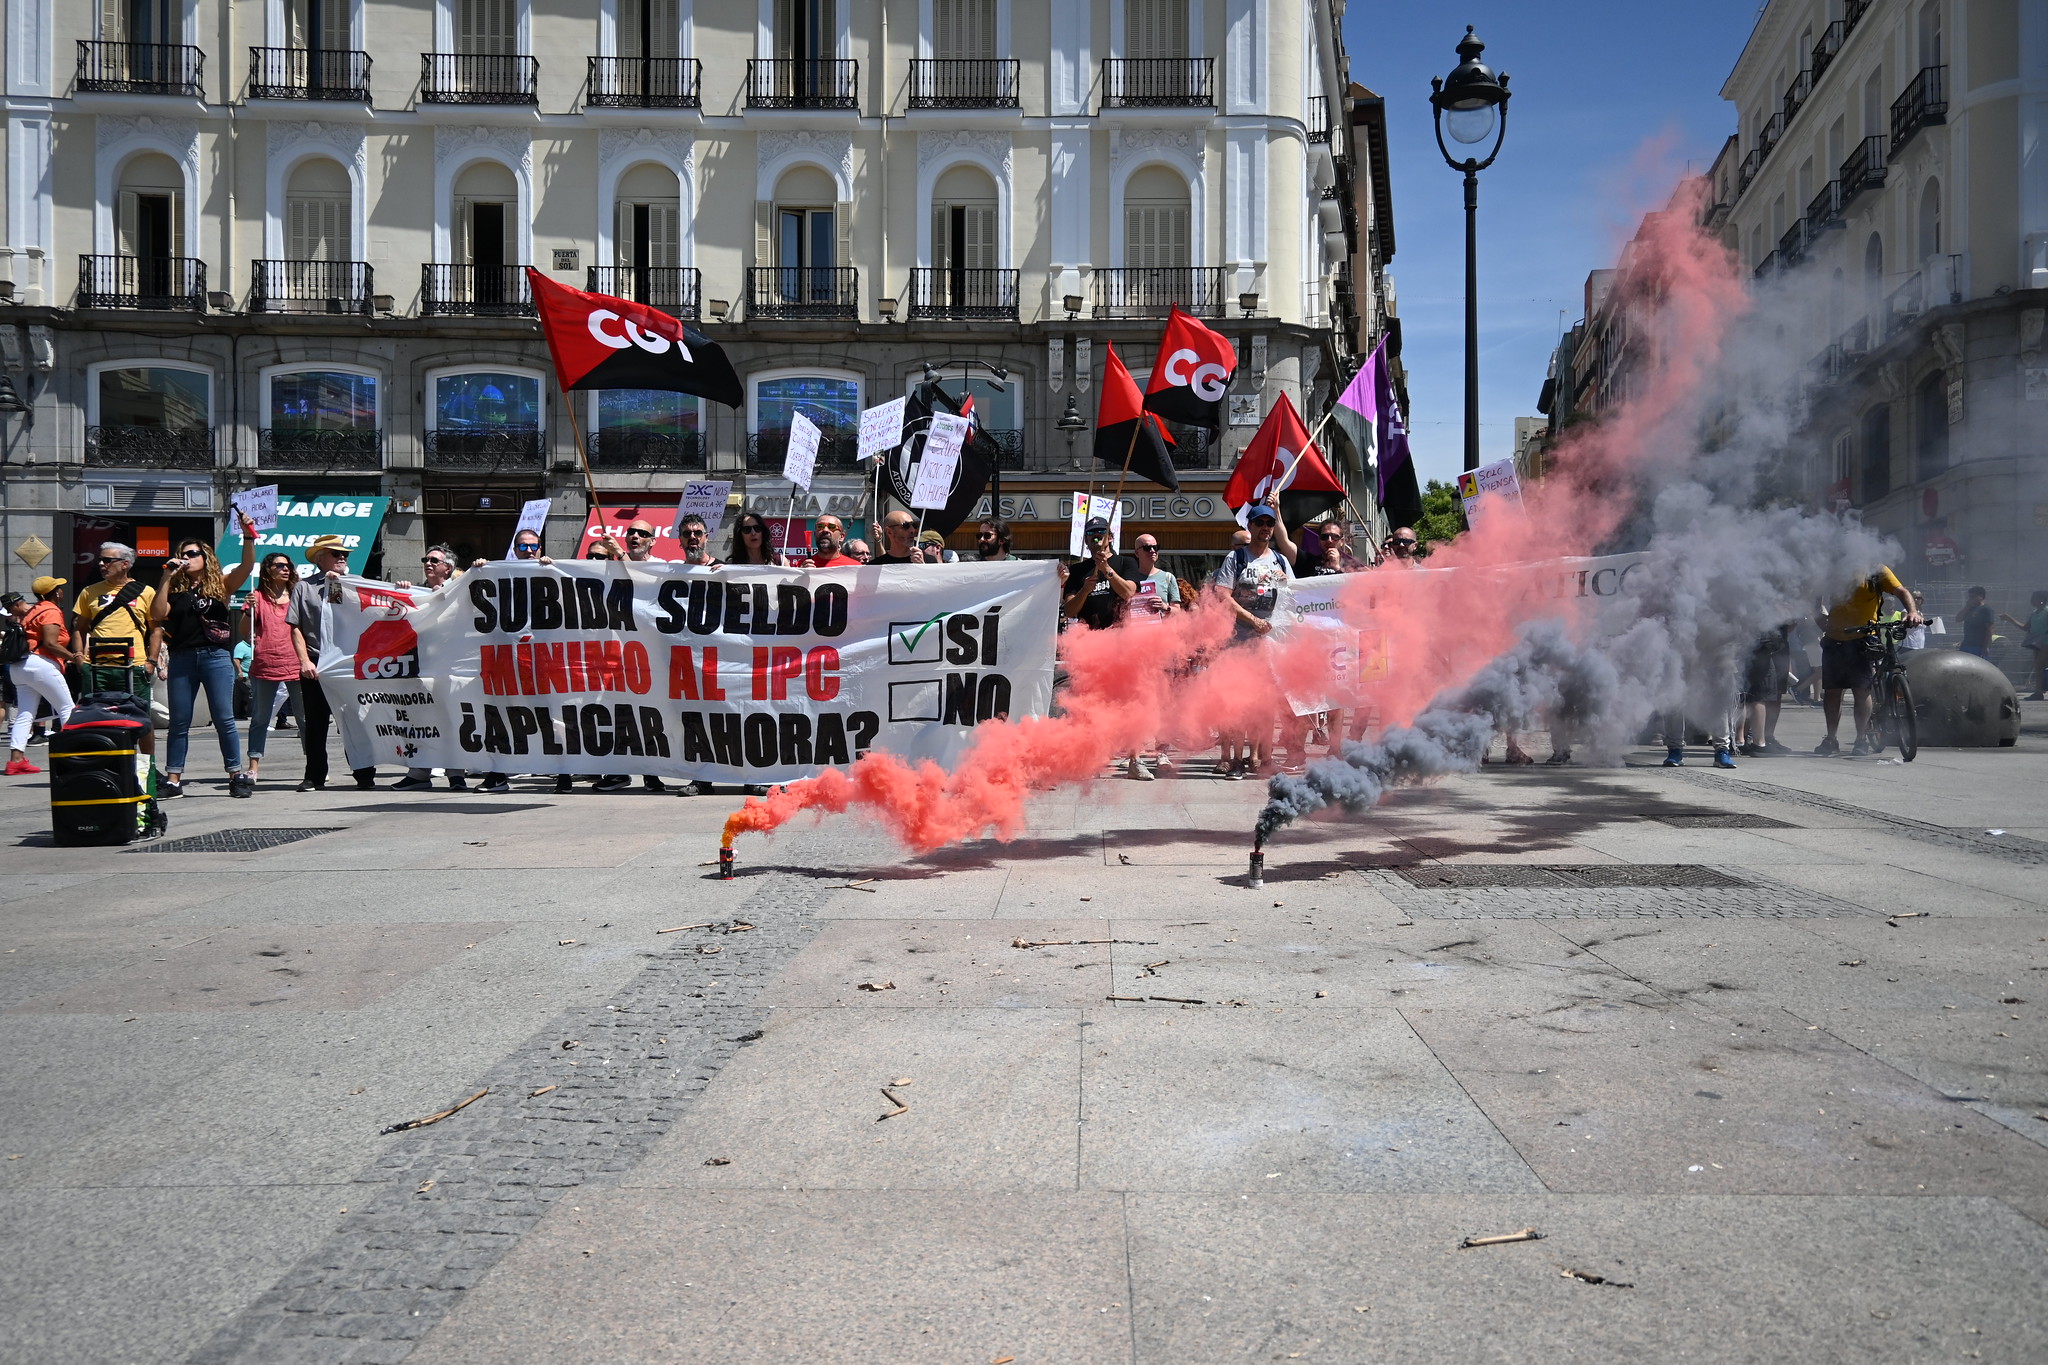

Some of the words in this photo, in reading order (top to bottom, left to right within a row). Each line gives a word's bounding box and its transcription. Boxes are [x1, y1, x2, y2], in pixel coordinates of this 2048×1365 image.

[559, 262, 573, 270] SOL
[936, 422, 954, 432] etronics
[1478, 467, 1503, 481] SOLO
[686, 484, 714, 496] DXC
[713, 486, 728, 497] NOS
[1480, 475, 1515, 493] PIENSA
[238, 494, 247, 502] TU
[251, 489, 274, 500] SALARIO
[252, 503, 267, 513] ROBA
[276, 501, 374, 518] HANGE
[686, 501, 714, 509] CONGELA
[829, 496, 864, 512] SOL
[969, 497, 1038, 519] ASA
[1059, 498, 1073, 519] D
[1121, 497, 1215, 519] DIEGO
[137, 548, 166, 556] orange
[469, 577, 638, 633] SUBIDA
[655, 579, 849, 637] SUELDO
[946, 605, 1003, 666] SÍ
[361, 655, 415, 679] CGT
[480, 635, 651, 696] MÍNIMO
[669, 645, 726, 701] AL
[752, 645, 840, 701] IPC
[357, 692, 435, 706] COORDINADORA
[943, 672, 1012, 726] NO
[396, 709, 410, 722] DE
[376, 724, 440, 739] INFORMÁTICA
[459, 702, 671, 758] ¿APLICAR
[681, 711, 880, 768] AHORA?
